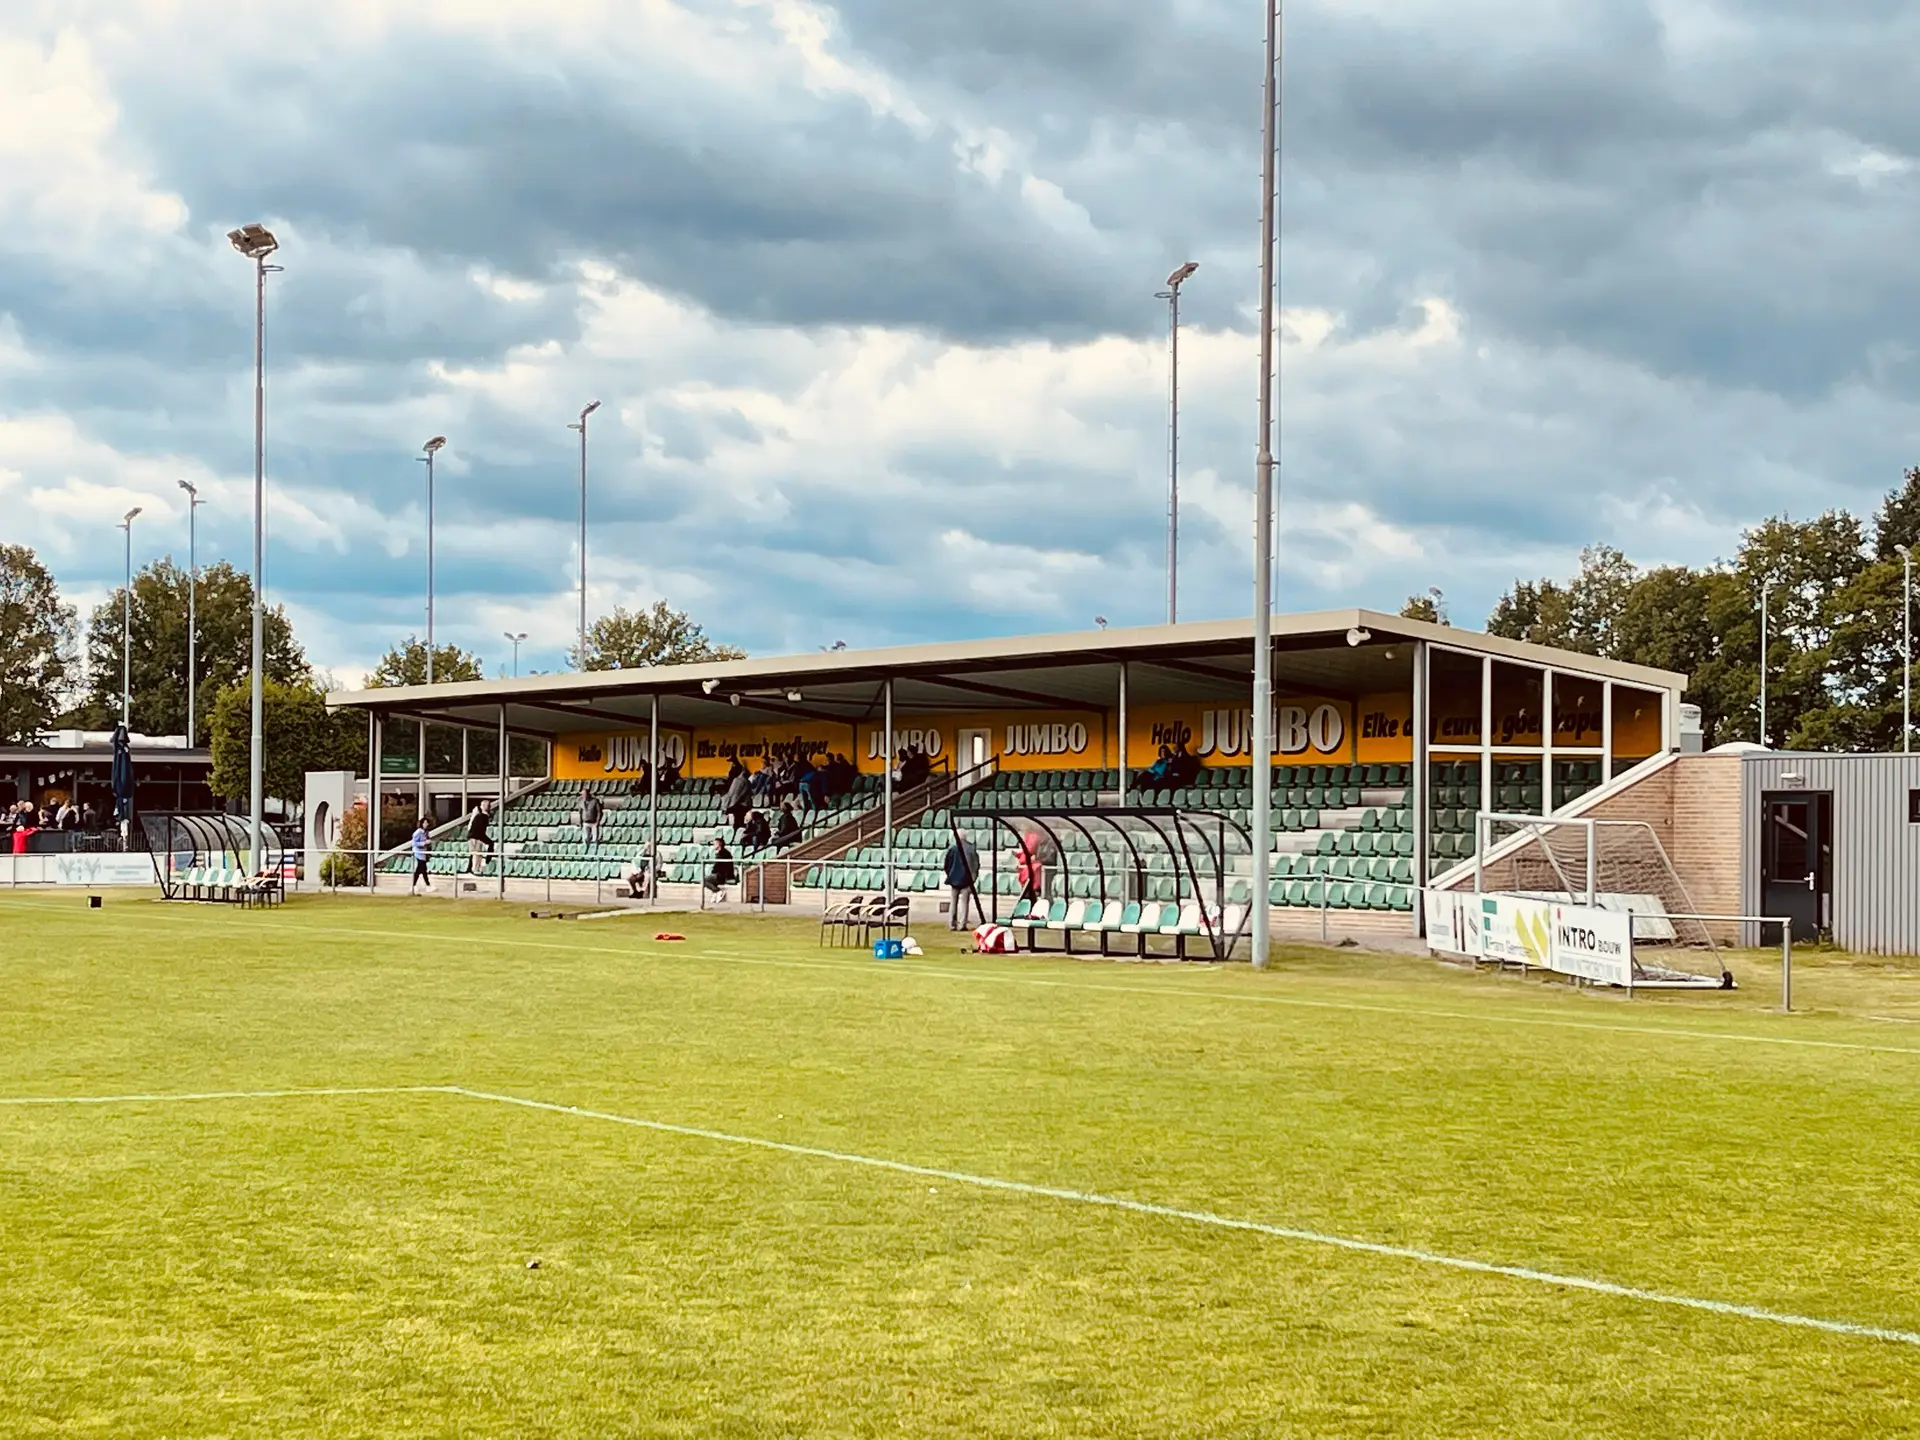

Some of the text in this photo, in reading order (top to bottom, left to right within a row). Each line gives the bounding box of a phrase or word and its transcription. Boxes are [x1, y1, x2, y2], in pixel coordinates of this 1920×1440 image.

[1003, 721, 1089, 755] JUMBO
[1151, 720, 1192, 746] Hallo
[1362, 711, 1398, 738] Elke
[867, 728, 943, 760] JUMBO
[1557, 925, 1596, 951] INTRO
[1597, 939, 1622, 955] BOUW
